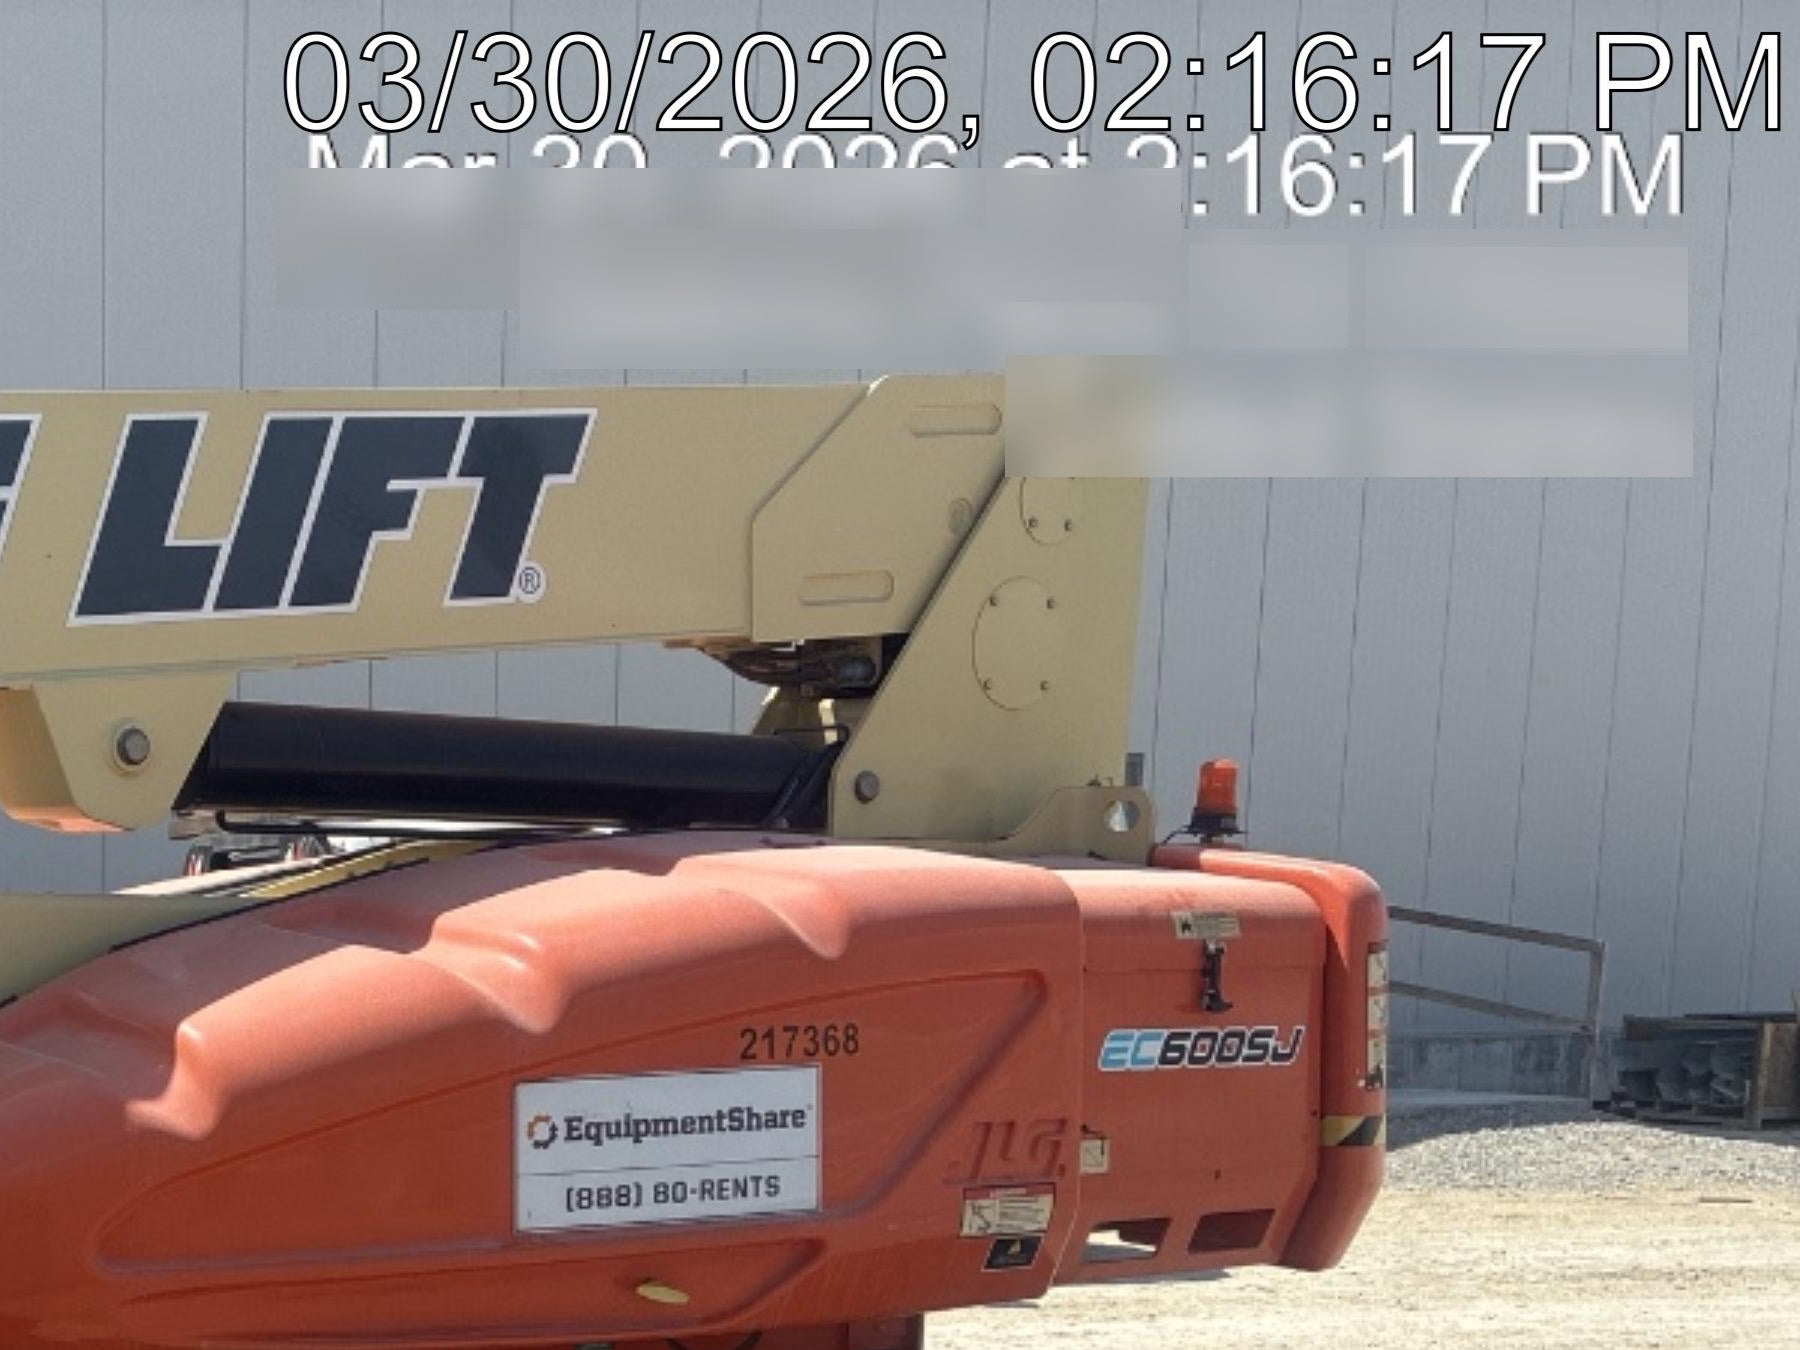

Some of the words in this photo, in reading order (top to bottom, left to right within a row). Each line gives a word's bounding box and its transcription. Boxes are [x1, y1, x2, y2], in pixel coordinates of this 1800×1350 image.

[67, 407, 596, 626] LIFT
[740, 1023, 860, 1060] 217368
[1098, 1026, 1304, 1071] EC600SJ
[564, 1107, 806, 1146] EquipmentShare
[566, 1181, 643, 1212] (888)
